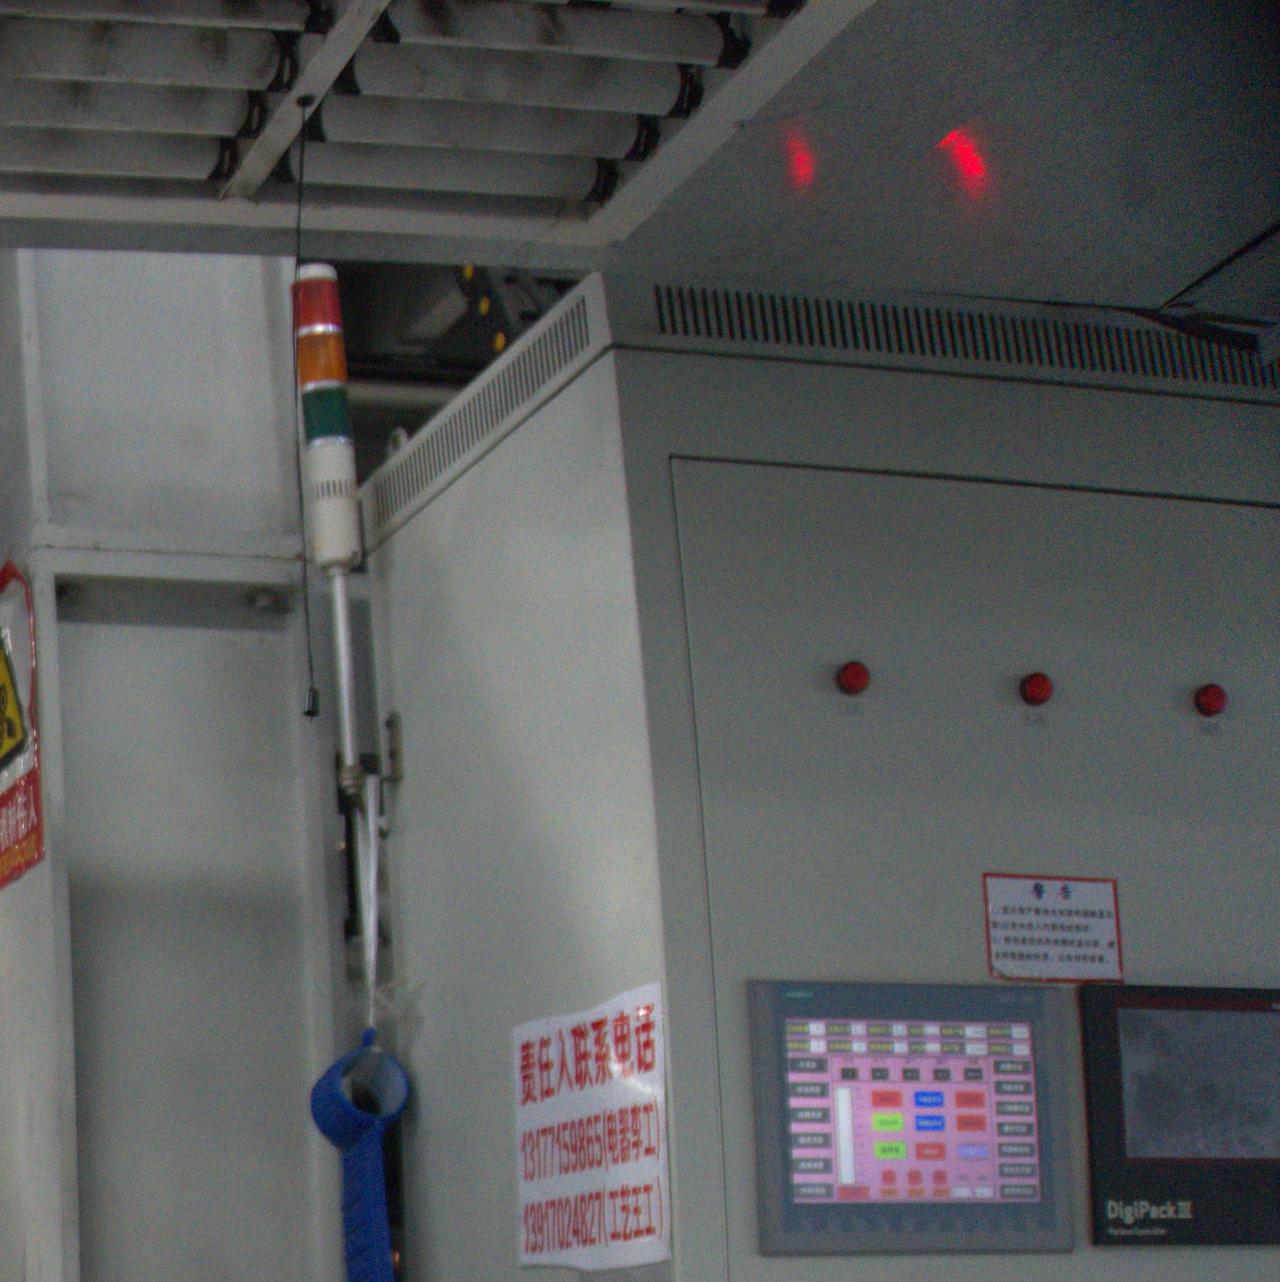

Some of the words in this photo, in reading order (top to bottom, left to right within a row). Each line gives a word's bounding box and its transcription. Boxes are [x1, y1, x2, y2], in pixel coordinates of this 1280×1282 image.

[520, 1003, 656, 1106] 责任人联系电话
